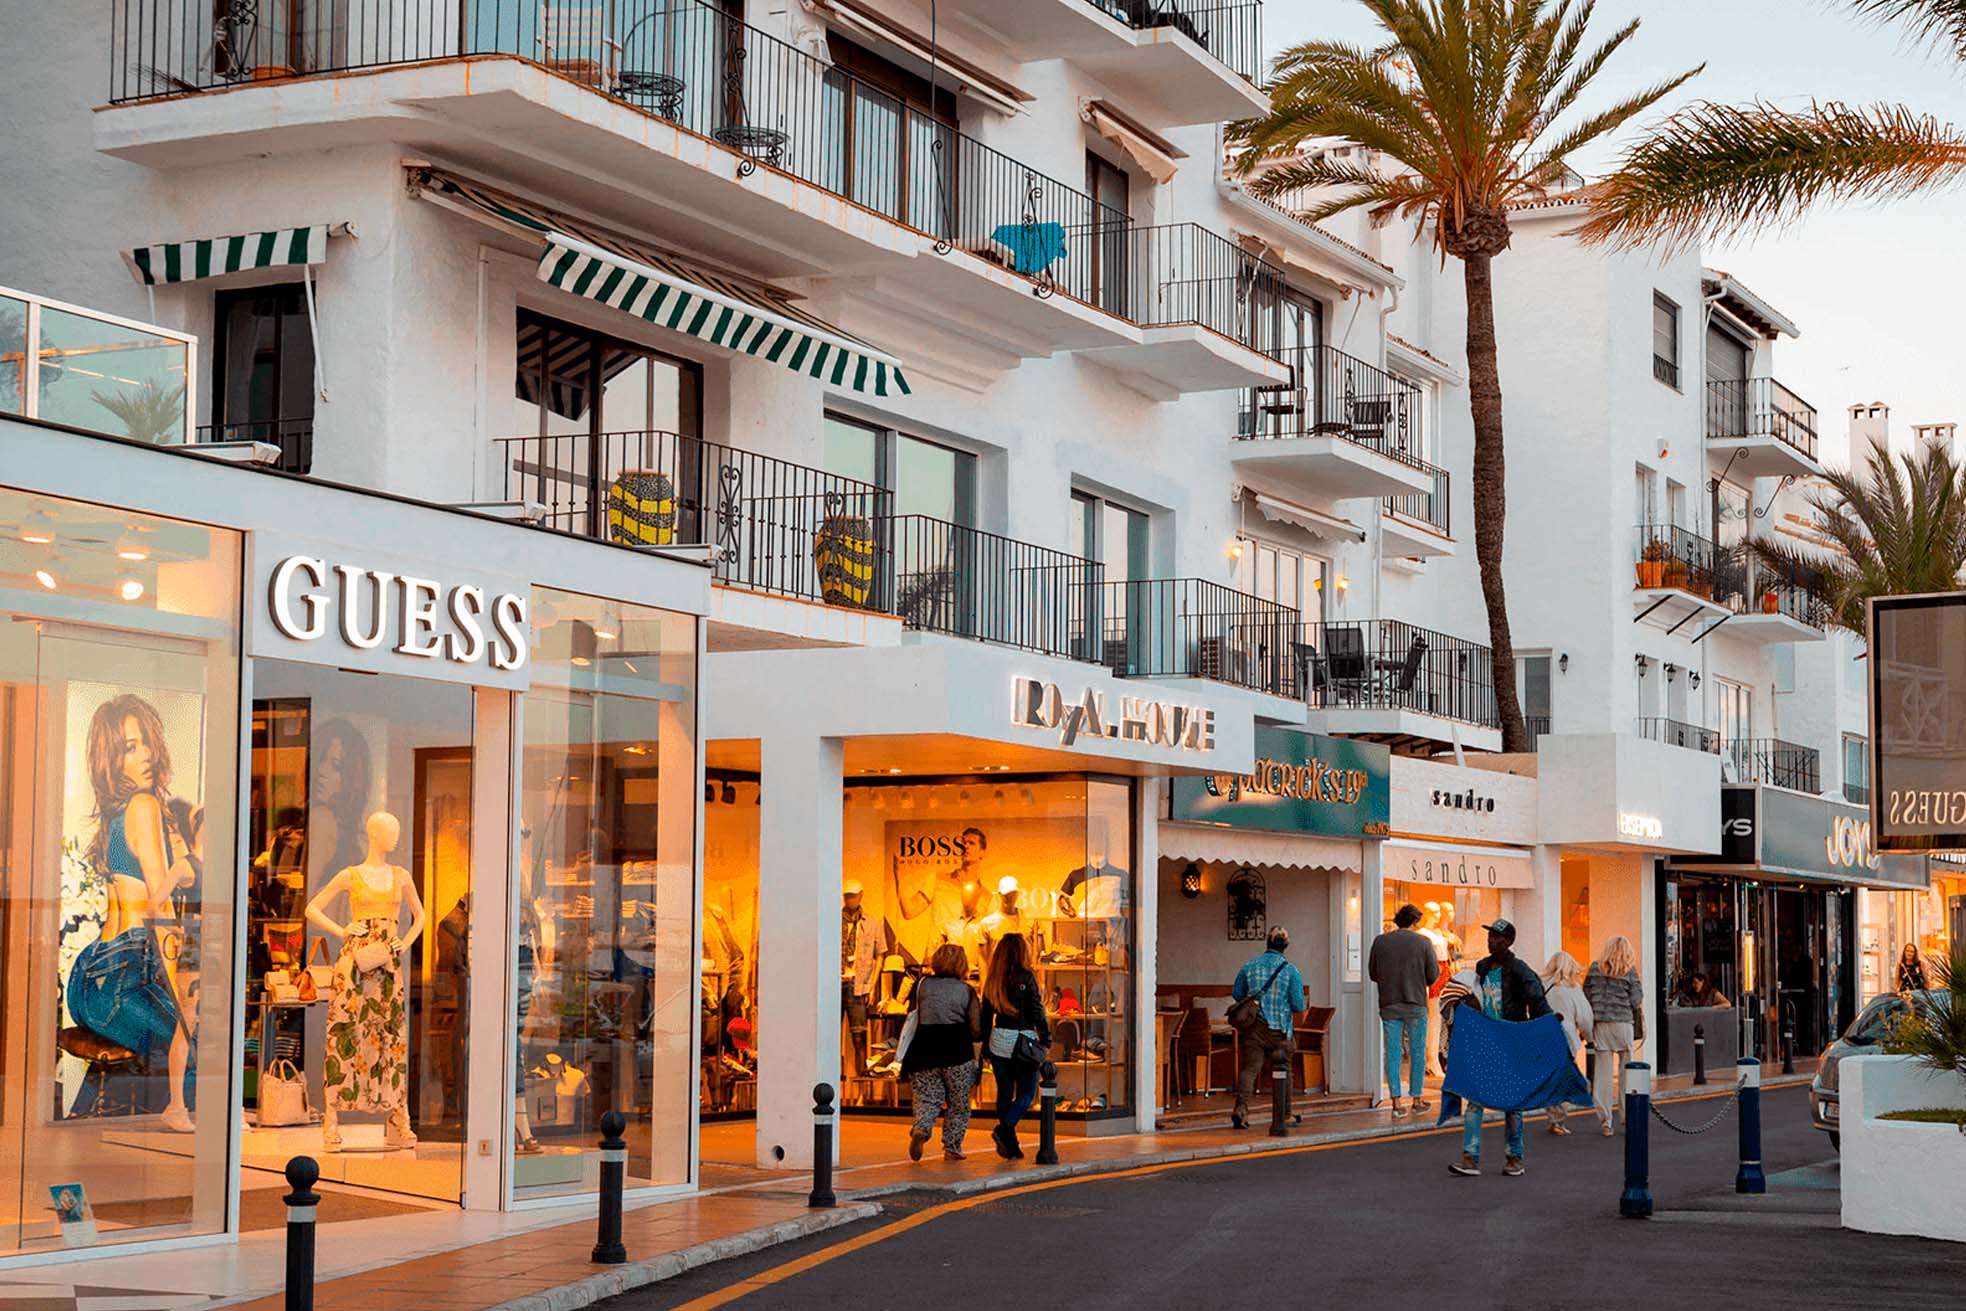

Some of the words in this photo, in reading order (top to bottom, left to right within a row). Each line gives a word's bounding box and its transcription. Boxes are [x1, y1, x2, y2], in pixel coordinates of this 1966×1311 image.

[268, 555, 526, 671] GUESS
[1432, 788, 1495, 812] sandro
[900, 836, 967, 858] BOSS
[1411, 855, 1497, 886] sandro
